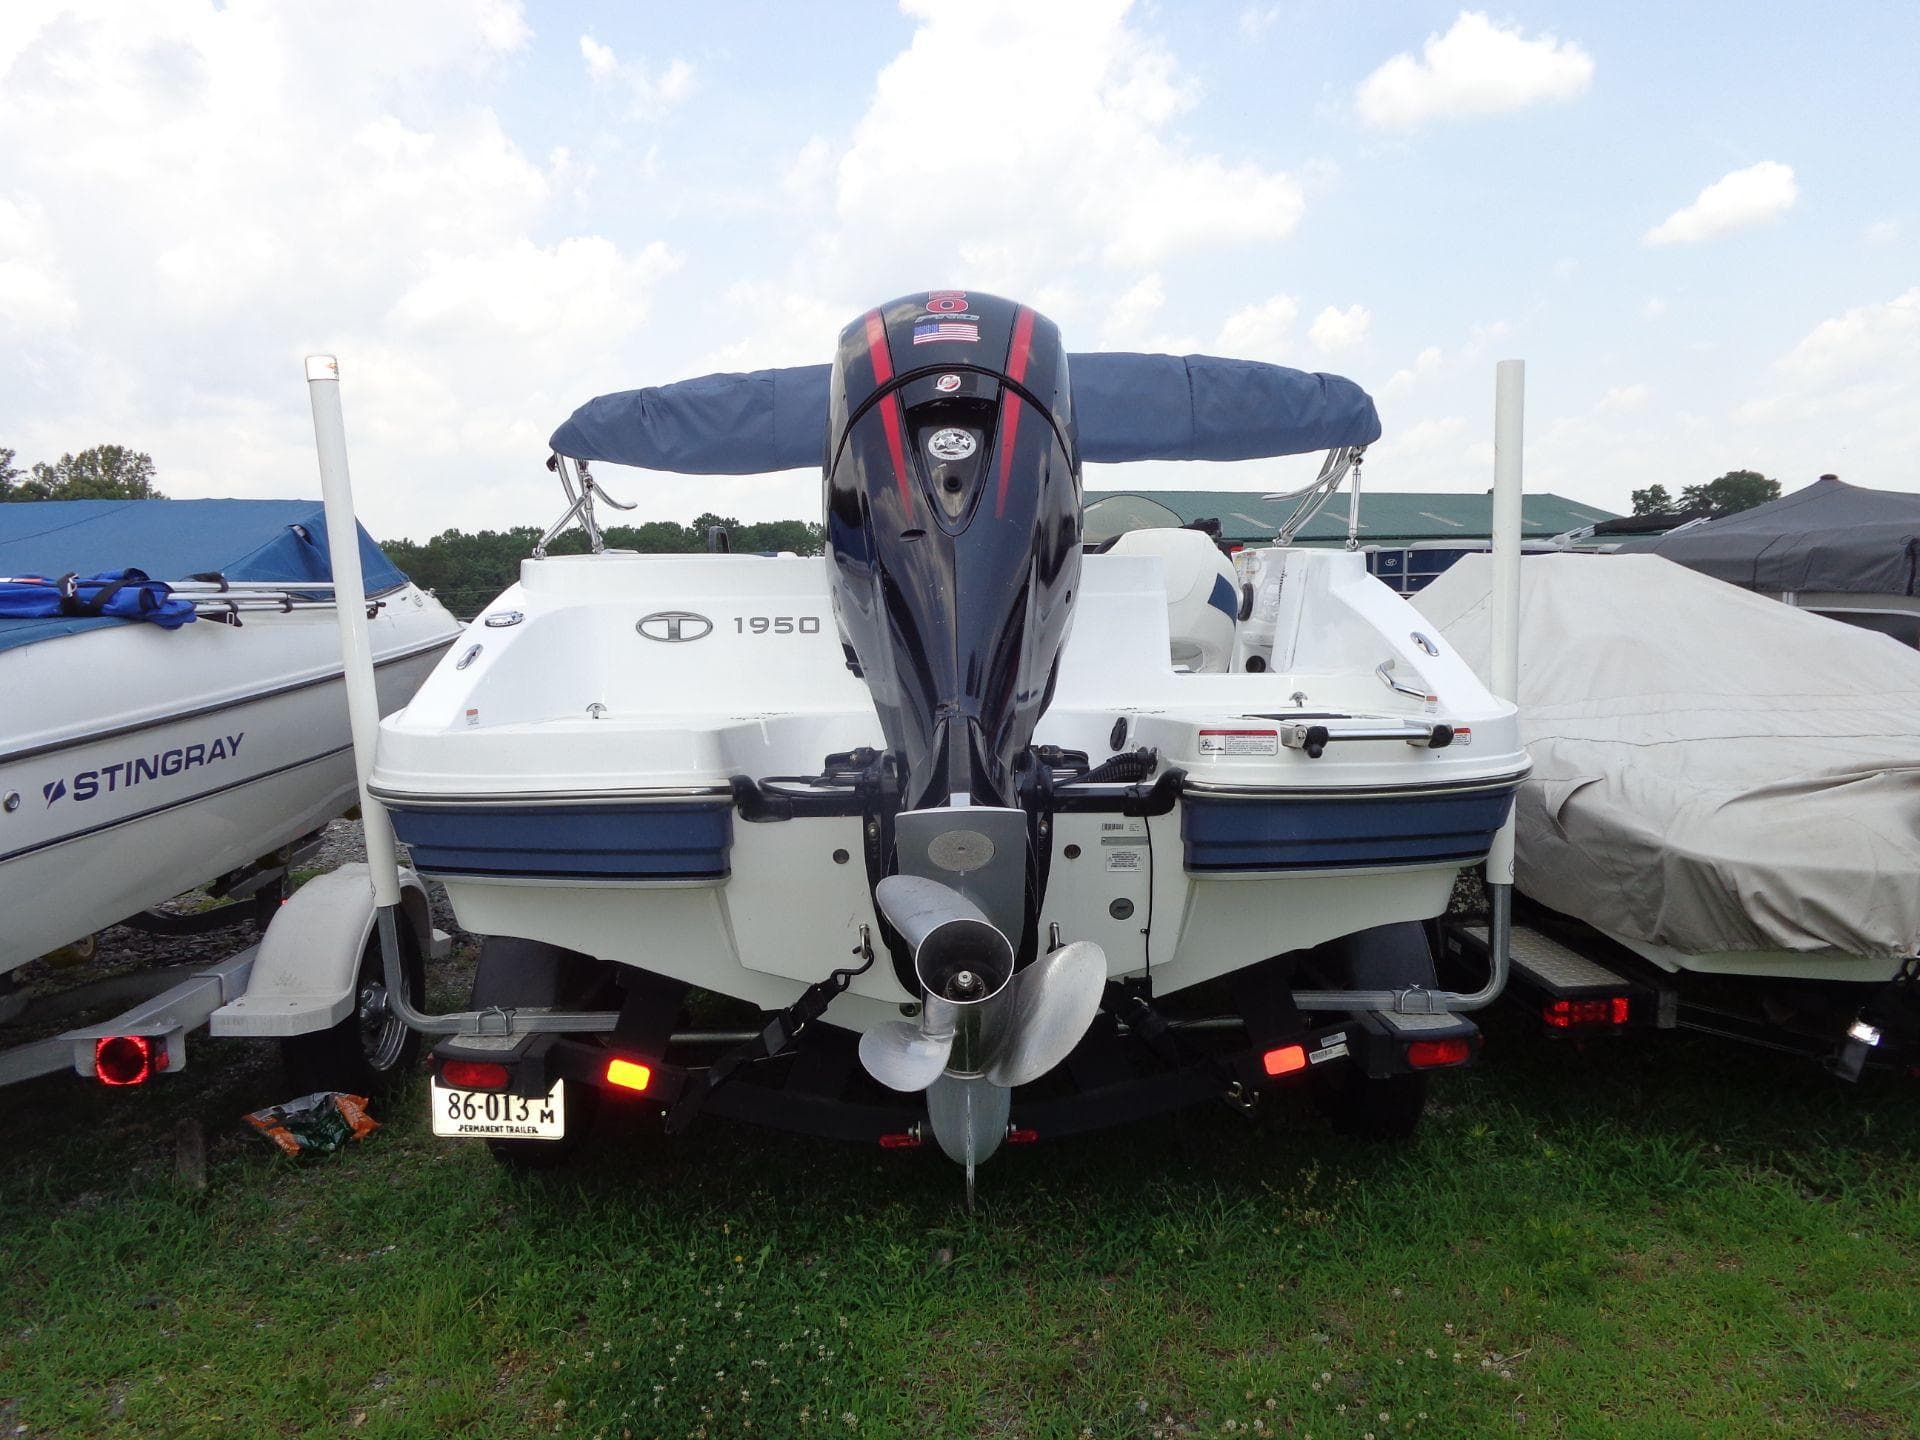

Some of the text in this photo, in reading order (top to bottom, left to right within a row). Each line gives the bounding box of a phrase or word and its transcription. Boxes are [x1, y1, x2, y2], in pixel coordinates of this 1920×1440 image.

[734, 616, 820, 634] 1950
[73, 732, 245, 802] STINGRAY
[458, 1124, 538, 1134] PERMANENT TRAILER
